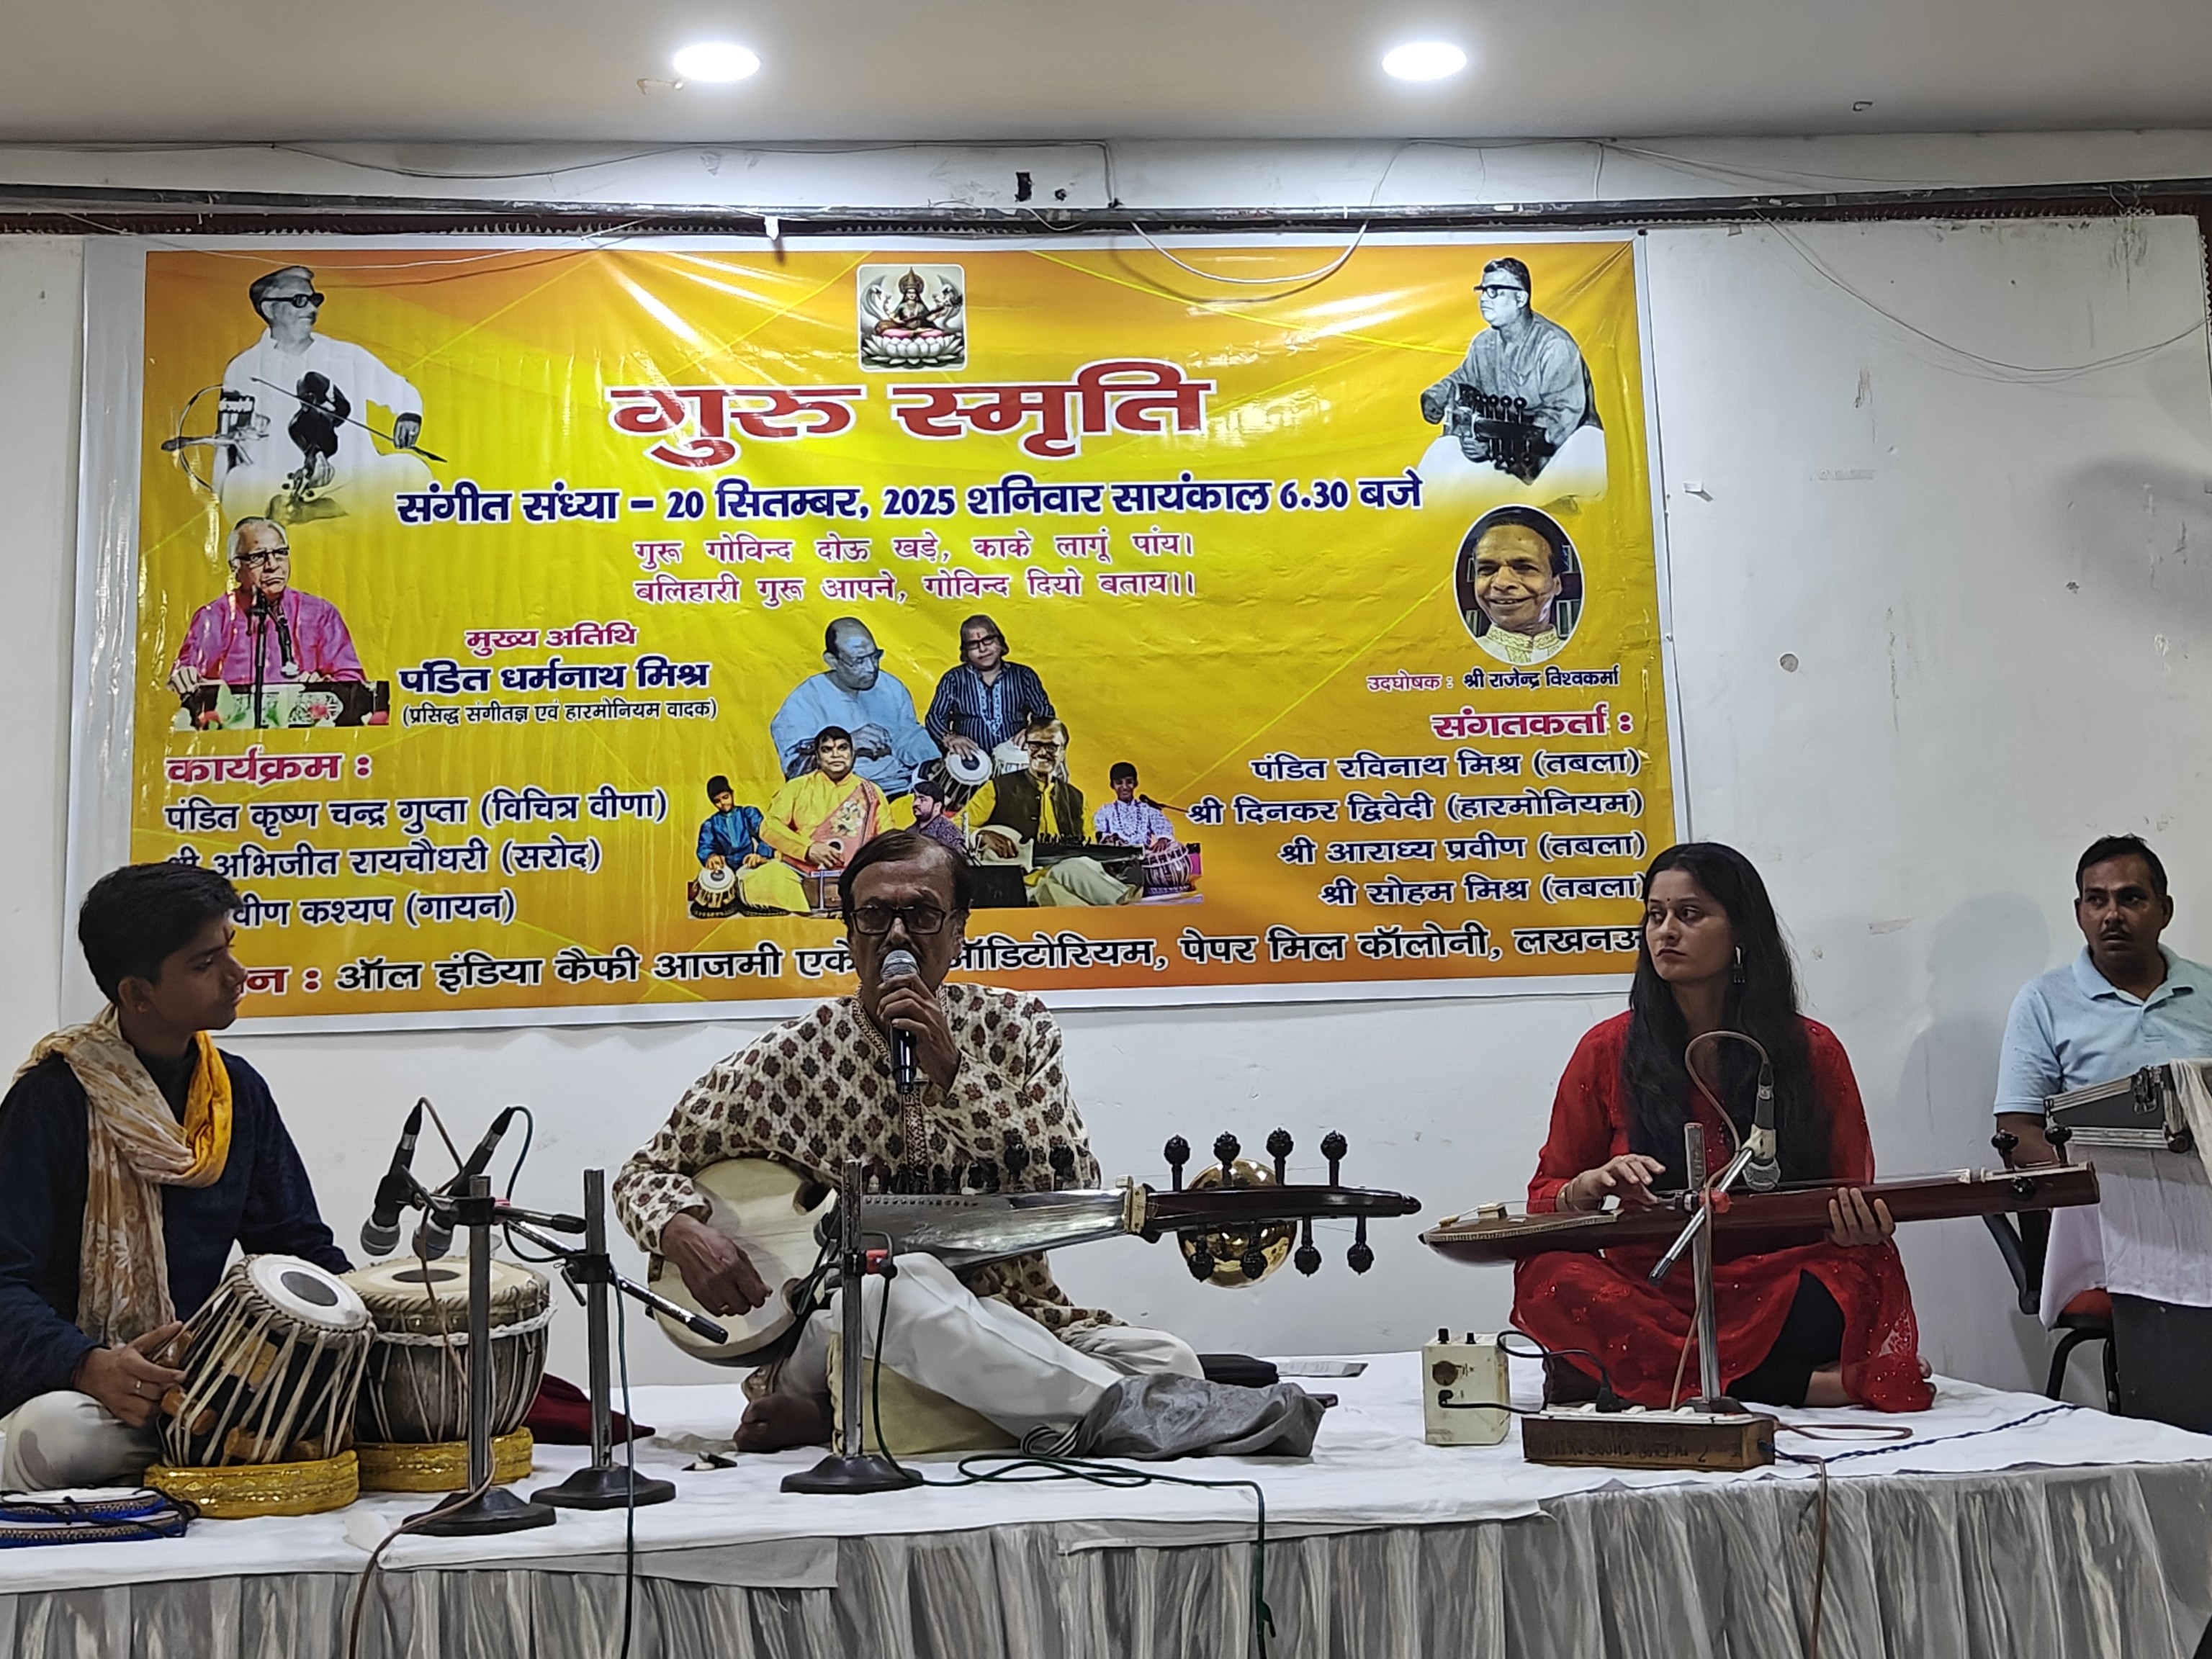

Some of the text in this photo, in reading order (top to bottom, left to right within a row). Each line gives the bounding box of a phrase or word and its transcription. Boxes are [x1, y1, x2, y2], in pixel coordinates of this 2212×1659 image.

[894, 364, 1212, 457] स्मृति
[396, 481, 513, 523] संगीत
[521, 481, 620, 521] संध्या
[667, 490, 704, 518] 20
[714, 478, 869, 519] सितम्बर,
[884, 488, 955, 516] 2025
[968, 474, 1105, 515] शनिवार
[1110, 472, 1272, 513] सायंकाल
[1280, 481, 1348, 509] 6.30
[1358, 469, 1423, 508] बजे
[706, 534, 792, 561] गोविन्द
[817, 533, 870, 560] दोऊ
[973, 531, 1031, 557] काके
[1056, 526, 1111, 562] लागूं
[635, 573, 739, 601] बलिहारी
[822, 571, 906, 601] आपने,
[924, 569, 1010, 597] गोविन्द
[1027, 568, 1081, 595] दियो
[466, 622, 637, 657] मुख्य अतिथि
[398, 655, 710, 694] पंडित धर्मनाथ मिश्र
[1367, 670, 1441, 691] उदघोषक
[1463, 667, 1485, 688] श्री
[1488, 667, 1542, 689] राजेन्द्र
[1545, 665, 1619, 687] विश्वकर्मा
[464, 700, 529, 723] संगीतज्ञ
[534, 699, 561, 721] एवं
[565, 697, 661, 721] हारमोनियम
[665, 698, 716, 719] वादक)
[1431, 703, 1607, 737] संगतकर्ता
[166, 747, 343, 786] कार्यक्रम
[1251, 748, 1642, 780] पंडित रविनाथ मिश्र (तबला)
[165, 786, 666, 837] पंडित कृष्ण चन्द्र गुप्ता (विचित्र वीणा)
[1189, 788, 1642, 823] श्री दिनकर द्विवेदी (हारमोनियम)
[213, 842, 340, 878] अभिजीत
[349, 837, 489, 873] रायचौधरी
[503, 835, 600, 873] (सरोद)
[1280, 832, 1645, 863] श्री आराध्य प्रवीण (तबला)
[1321, 873, 1642, 904] श्री सोहम मिश्र (तबला)
[300, 899, 394, 924] कश्यप
[407, 890, 514, 925] (गायन)
[338, 958, 422, 989] ऑल
[434, 952, 543, 992] इंडिया
[554, 947, 640, 982] कैफी
[655, 942, 783, 978] आजमी
[1180, 929, 1257, 962] पेपर
[1267, 927, 1346, 960] मिल
[1357, 922, 1500, 959] कॉलोनी,
